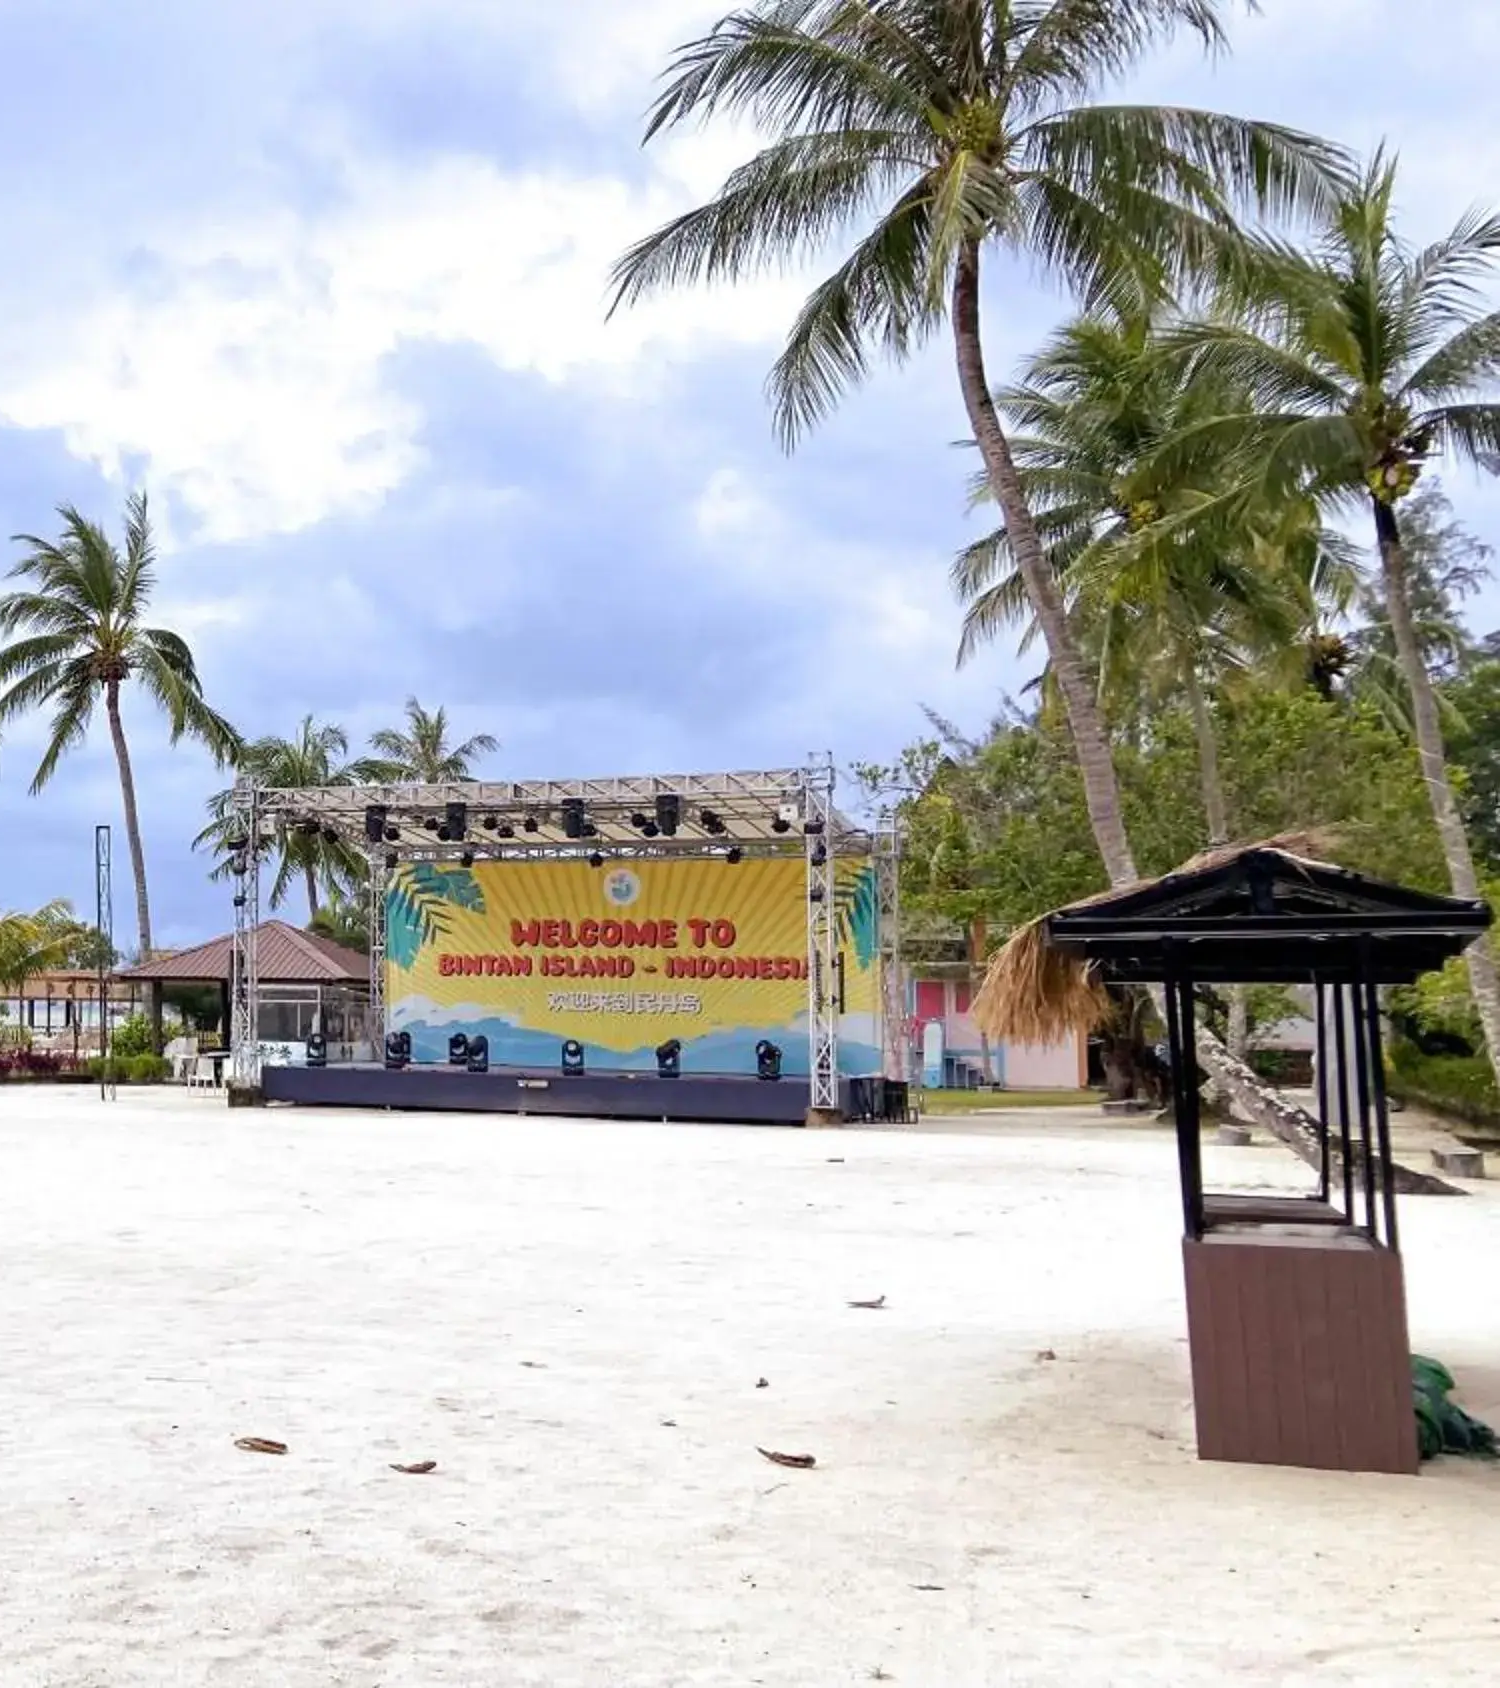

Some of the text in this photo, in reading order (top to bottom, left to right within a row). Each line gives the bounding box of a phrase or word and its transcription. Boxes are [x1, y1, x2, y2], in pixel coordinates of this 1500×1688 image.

[510, 918, 736, 948] WELCOME TO
[438, 953, 533, 976] BINTAN
[540, 955, 635, 978] ISLAND
